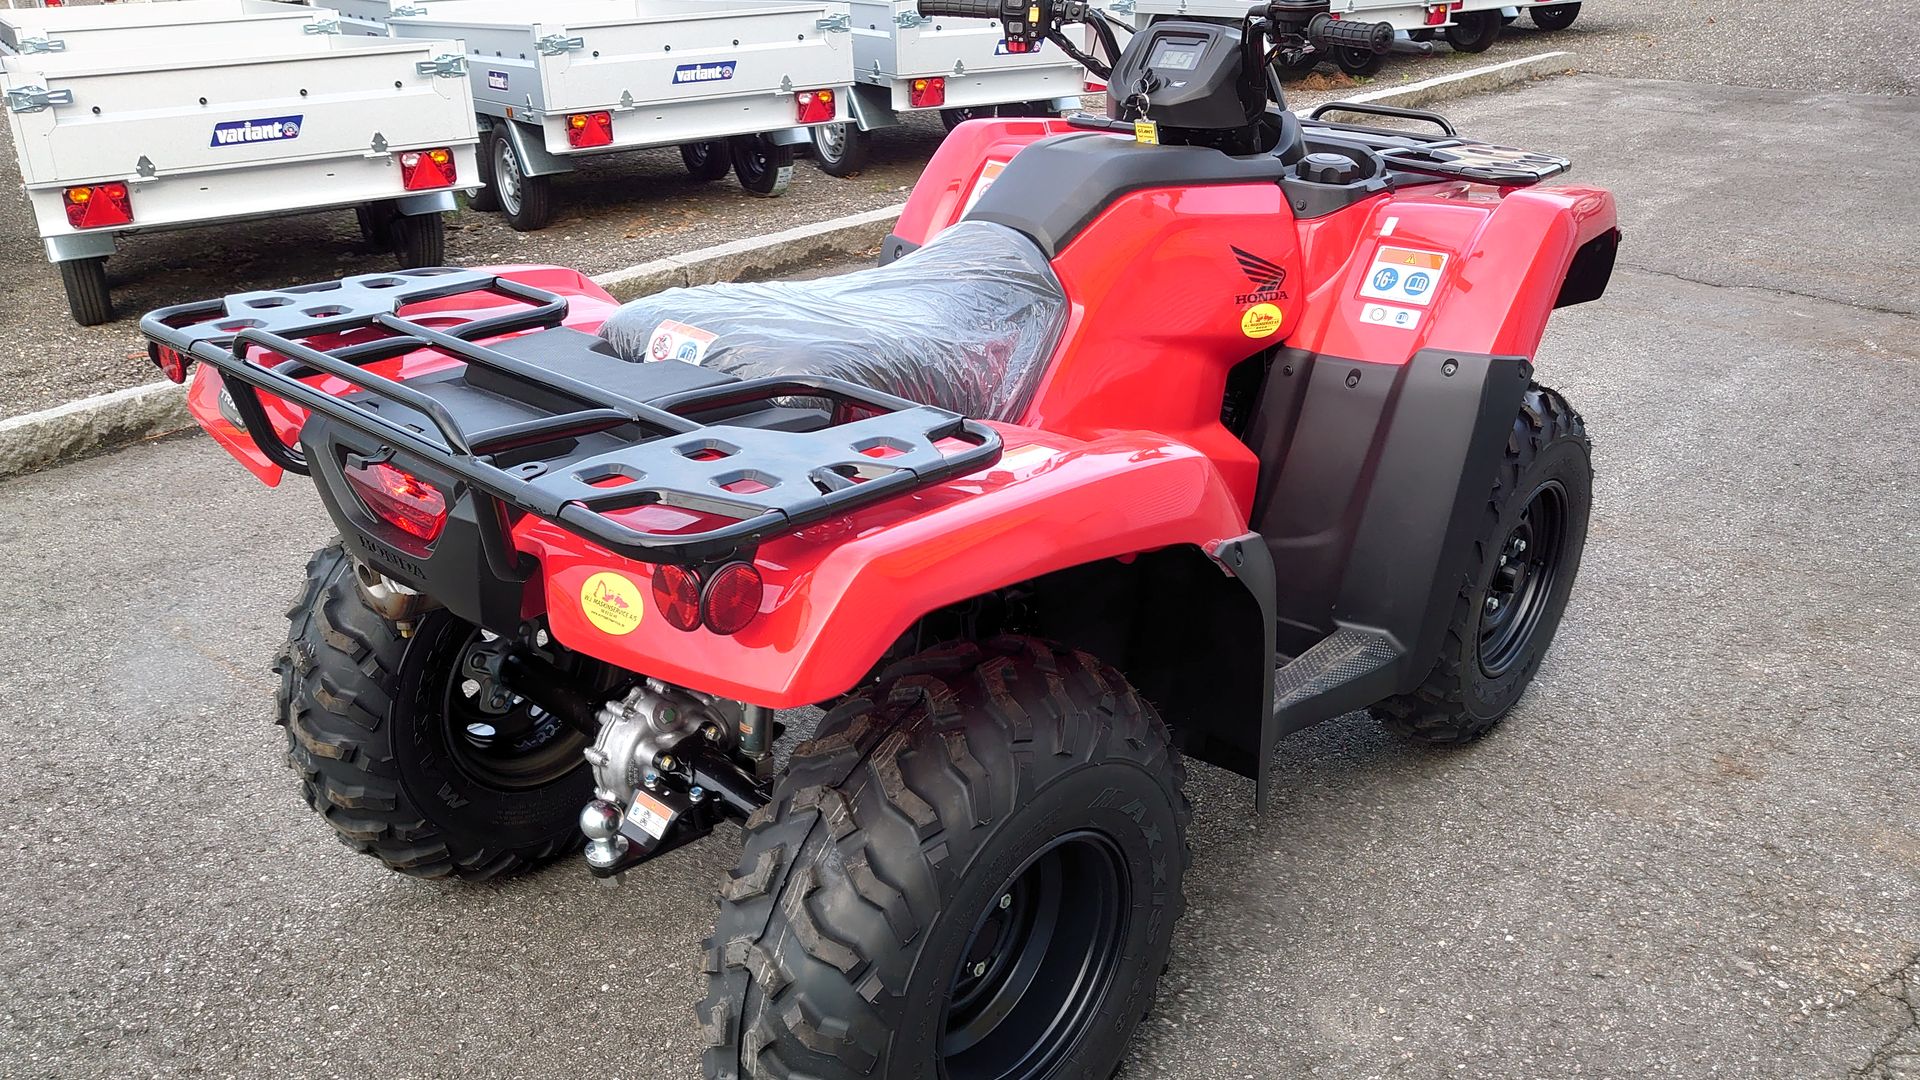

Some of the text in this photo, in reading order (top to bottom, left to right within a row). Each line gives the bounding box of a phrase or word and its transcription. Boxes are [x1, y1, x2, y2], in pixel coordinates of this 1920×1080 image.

[676, 64, 722, 82] variant
[215, 121, 283, 144] variant
[1375, 271, 1396, 288] 16+
[1235, 291, 1289, 305] HONDA
[356, 534, 428, 580] HONDA
[1088, 787, 1169, 945] MAXXIS
